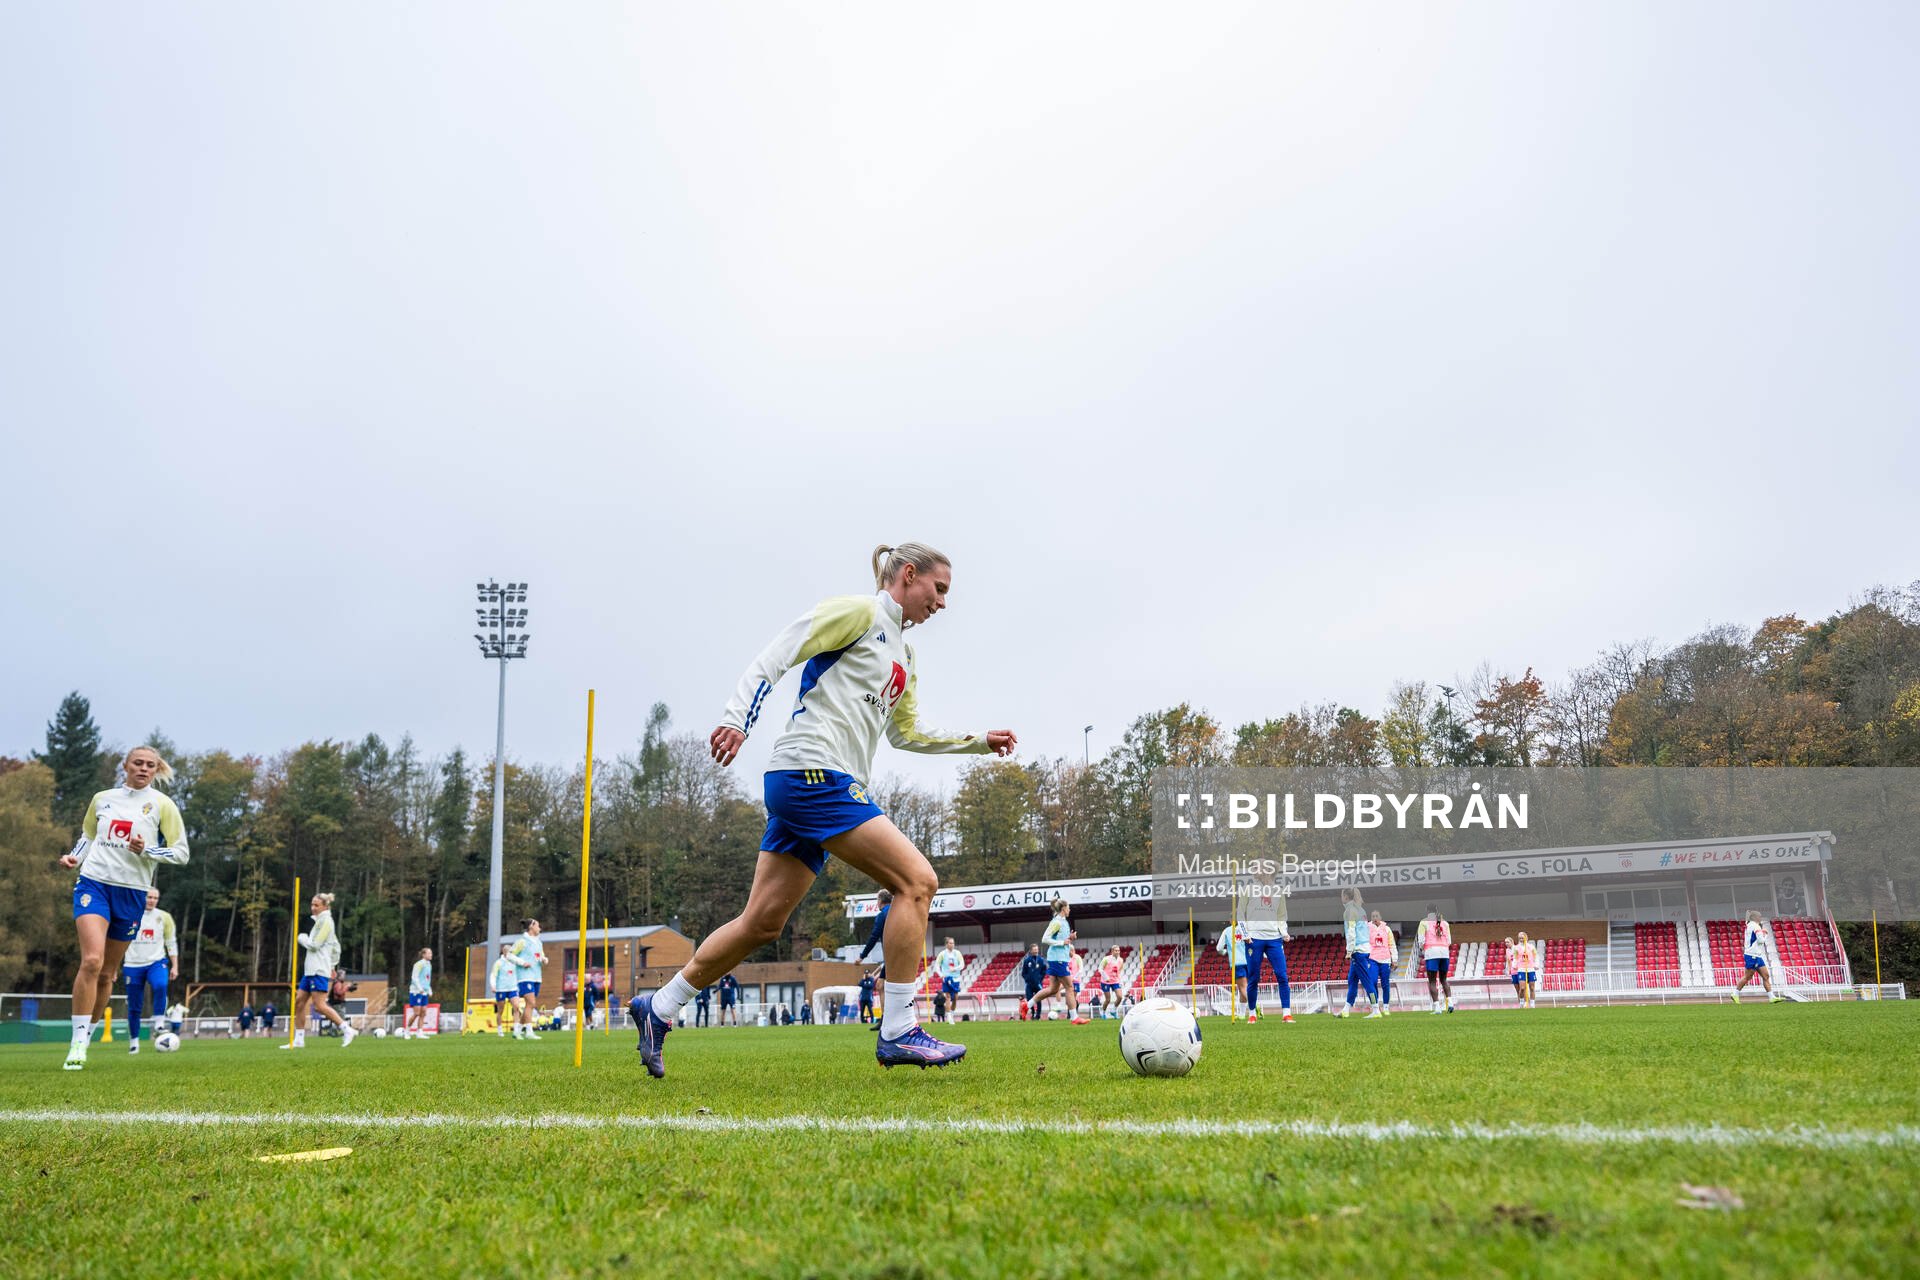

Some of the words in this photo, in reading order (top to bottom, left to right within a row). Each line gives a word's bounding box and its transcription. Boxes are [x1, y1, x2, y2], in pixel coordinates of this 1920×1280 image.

[1497, 861, 1535, 876] C.S.
[1541, 857, 1593, 873] FOLA
[1659, 852, 1697, 867] #WE
[1702, 850, 1744, 862] PLAY
[1748, 848, 1770, 859] AS
[1775, 846, 1811, 858] ONE
[1109, 884, 1162, 899] STADE
[1337, 866, 1442, 886] MAYRISCH
[992, 893, 1021, 906] C.A.
[1024, 890, 1061, 904] FOLA
